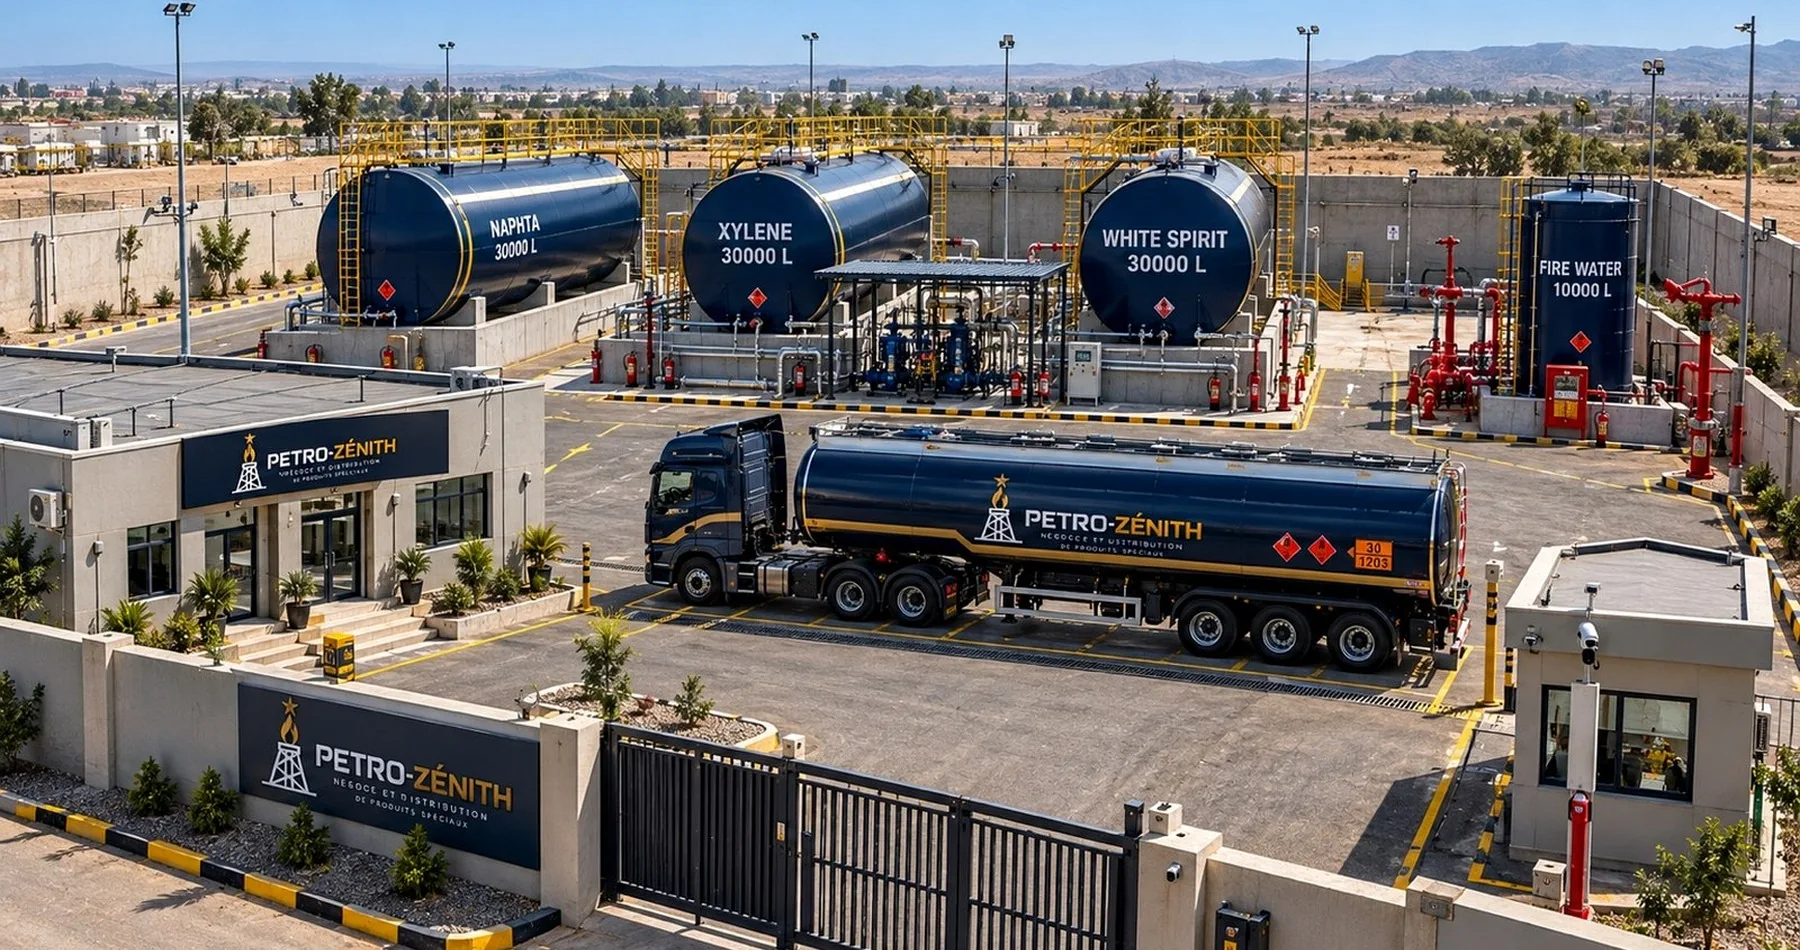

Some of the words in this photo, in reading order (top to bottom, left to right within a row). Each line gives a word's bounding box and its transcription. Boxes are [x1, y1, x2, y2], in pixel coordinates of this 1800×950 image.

[490, 214, 540, 238] NAPHTA
[718, 222, 793, 240] XYLENE
[1102, 229, 1161, 248] WHITE
[1167, 230, 1228, 249] SPIRIT
[495, 239, 528, 260] 30000
[531, 238, 538, 254] L
[721, 247, 776, 264] 30000
[782, 247, 793, 264] L
[1127, 254, 1188, 273] 30000
[1195, 255, 1207, 273] L
[1540, 260, 1570, 276] FIRE
[1574, 261, 1622, 276] WATER
[1553, 282, 1600, 297] 10000
[1604, 282, 1612, 297] L
[267, 438, 396, 470] PETRO-ZÉNITH
[1025, 510, 1203, 540] PETRO-ZÉNITH
[1366, 542, 1381, 553] 30
[315, 743, 513, 812] PETRO-ZÉNITH
[355, 795, 366, 803] DE
[382, 789, 395, 798] ET
[401, 793, 488, 821] DISTRIBUTION
